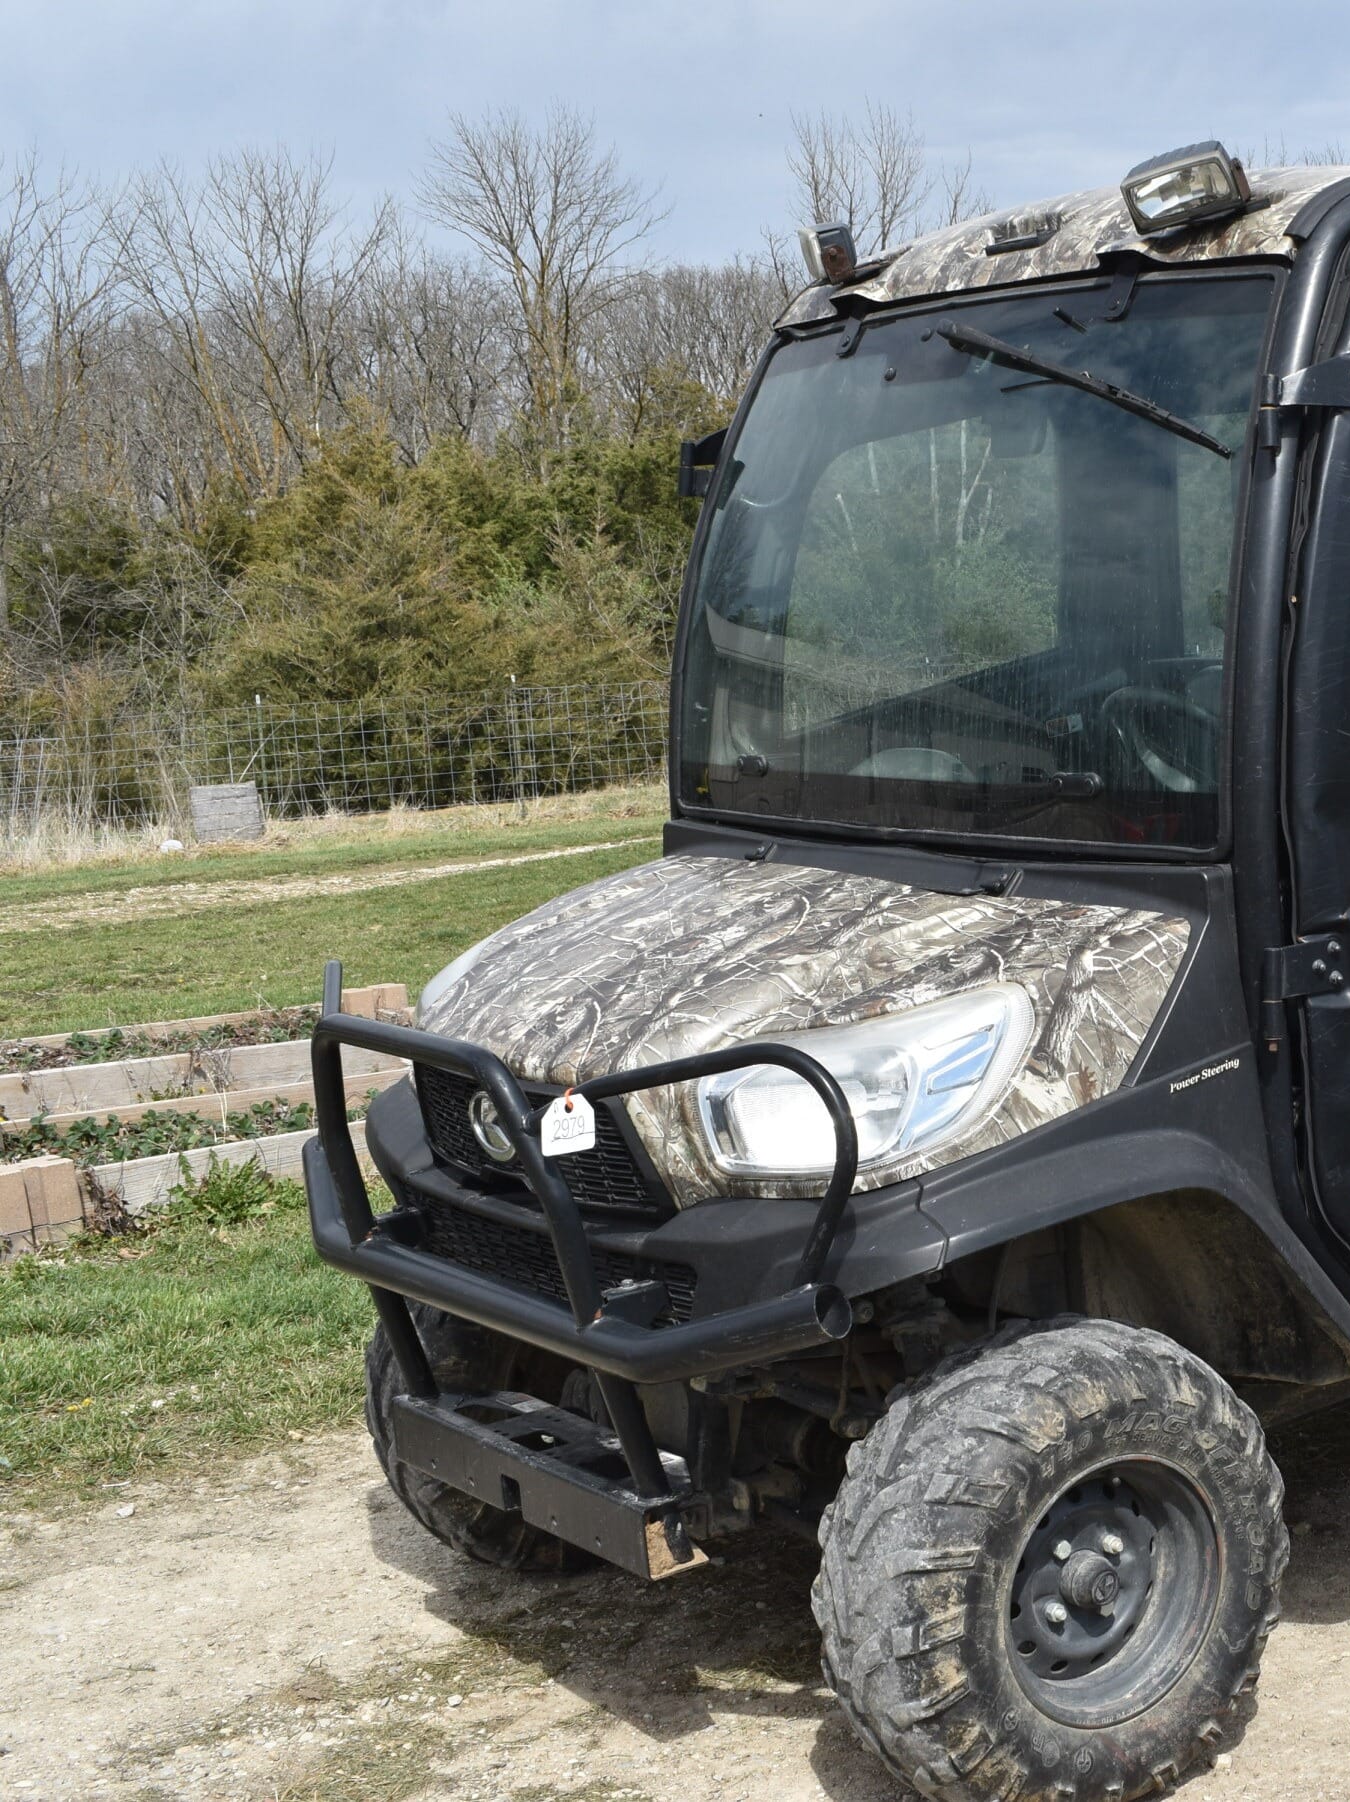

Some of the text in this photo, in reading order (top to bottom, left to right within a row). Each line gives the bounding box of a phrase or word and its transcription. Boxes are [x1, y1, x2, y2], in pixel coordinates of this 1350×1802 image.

[1169, 1058, 1240, 1093] Power Steering
[553, 1115, 585, 1139] 2979
[1102, 1411, 1189, 1440] MAG
[1239, 1493, 1265, 1611] ROAD
